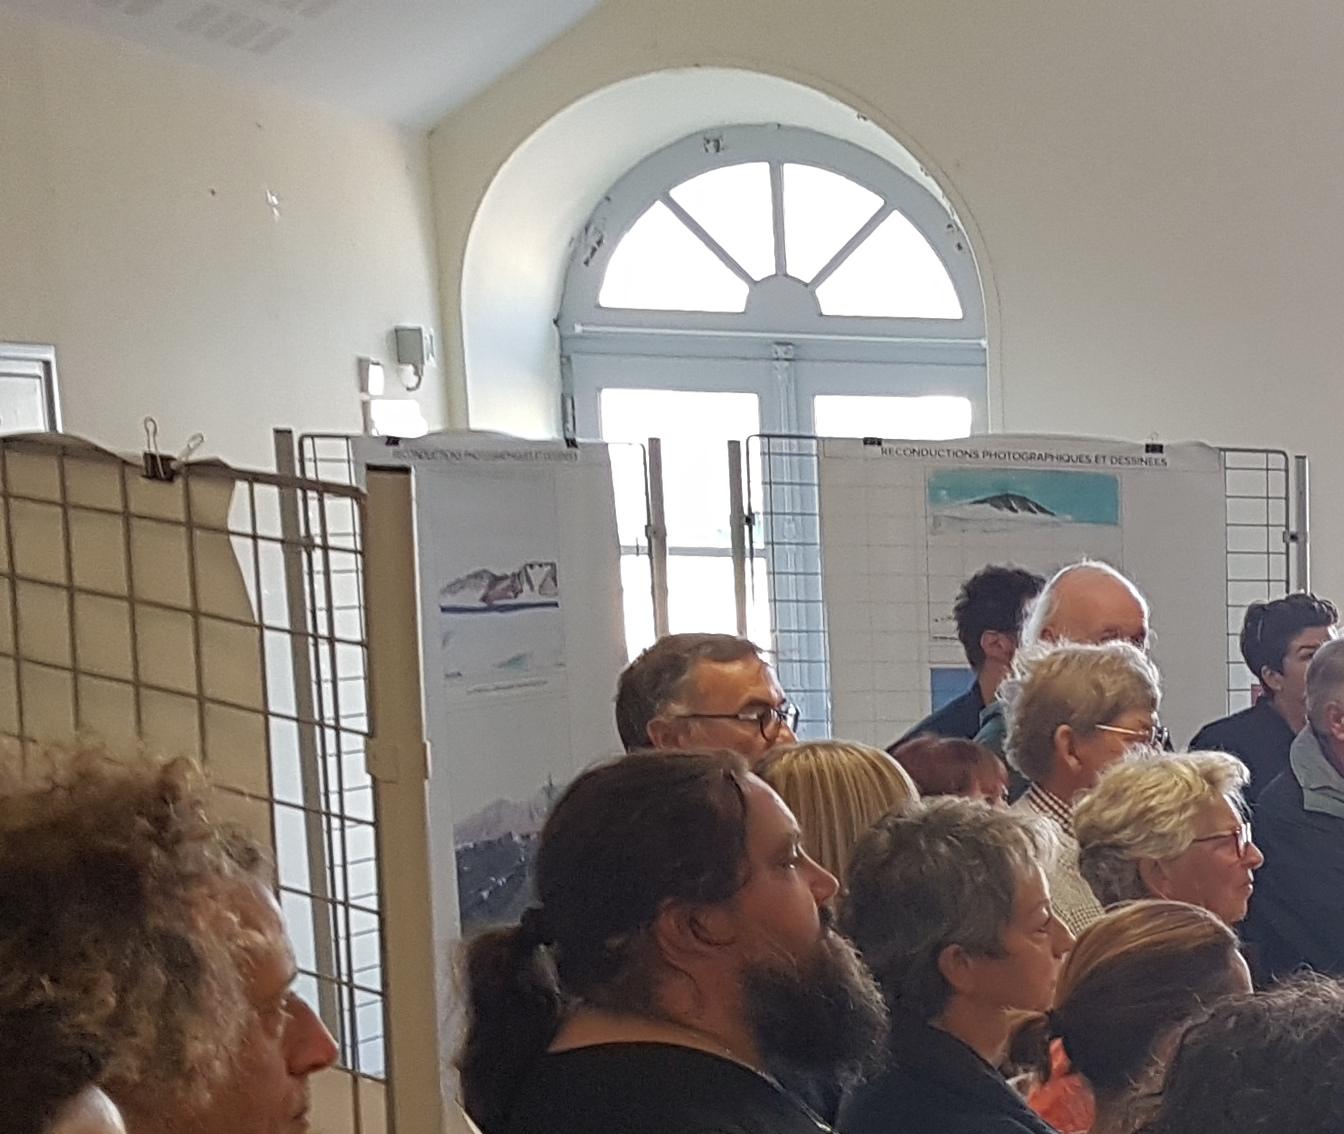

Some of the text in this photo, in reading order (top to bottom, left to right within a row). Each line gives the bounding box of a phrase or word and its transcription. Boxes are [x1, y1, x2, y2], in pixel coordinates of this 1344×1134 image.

[880, 446, 980, 460] RECONDUCTIONS
[982, 449, 1092, 465] PHOTOGRAPHIQUES
[1094, 453, 1106, 465] ET
